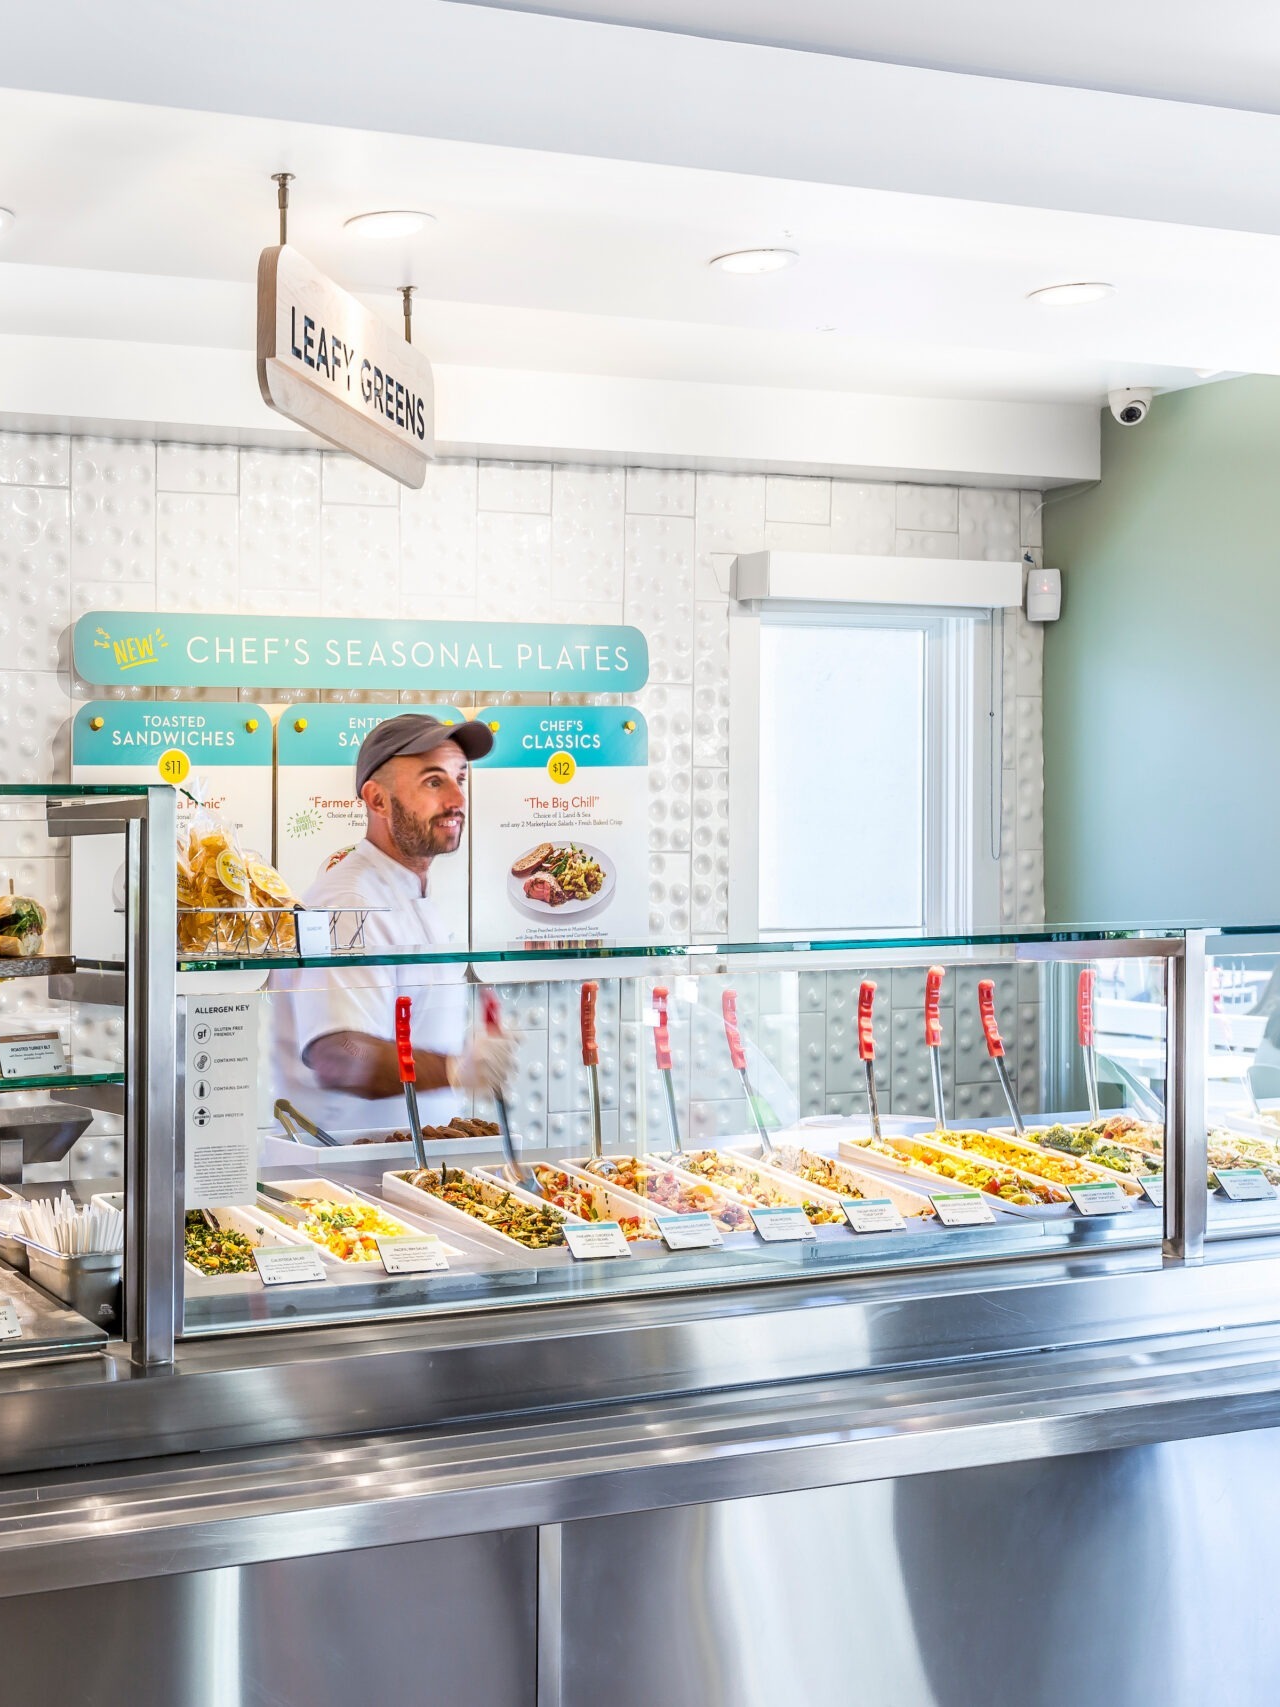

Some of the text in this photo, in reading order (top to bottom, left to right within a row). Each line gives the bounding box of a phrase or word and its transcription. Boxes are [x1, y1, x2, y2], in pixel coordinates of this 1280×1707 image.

[289, 304, 427, 443] LEAFY GREENS
[114, 634, 156, 665] NEW
[186, 635, 629, 672] CHEF'S SEASONAL PLATES
[143, 715, 206, 728] TOASTED
[539, 720, 584, 732] CHEF'S
[112, 730, 235, 746] SANDWICHES
[522, 734, 601, 749] CLASSICS
[164, 760, 181, 775] $11
[552, 762, 570, 776] $12
[524, 796, 600, 811] "The Big Chill"
[525, 821, 557, 829] Marketplace
[194, 1004, 250, 1015] ALLERGEN KEY
[197, 1029, 207, 1039] gf
